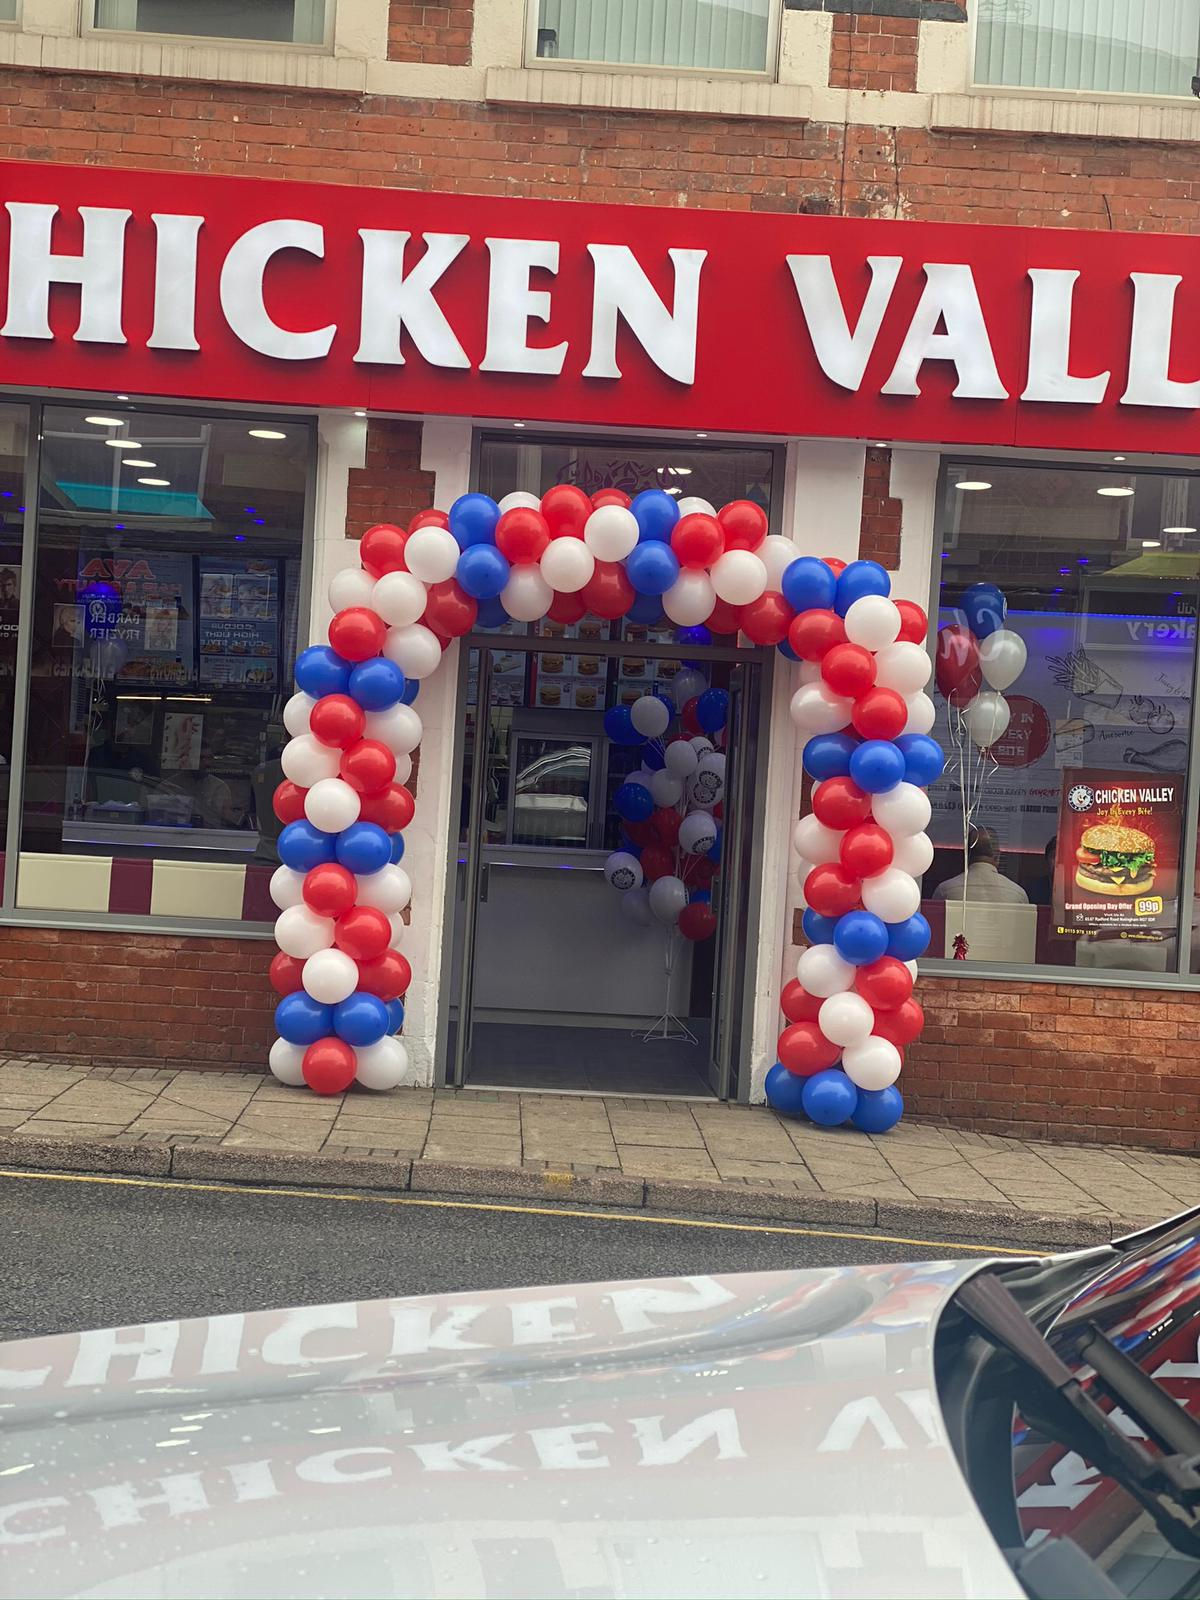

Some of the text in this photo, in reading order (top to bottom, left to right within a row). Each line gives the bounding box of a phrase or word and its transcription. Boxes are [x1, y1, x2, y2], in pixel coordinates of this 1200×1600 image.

[1095, 789, 1137, 804] CHICKEN
[1139, 788, 1174, 802] VALLEY
[1096, 807, 1108, 816] Joy
[1118, 808, 1136, 816] Every
[1137, 807, 1153, 816] Bite!
[1065, 902, 1132, 910] Grand Opening Day Offer
[1139, 901, 1159, 912] 99p
